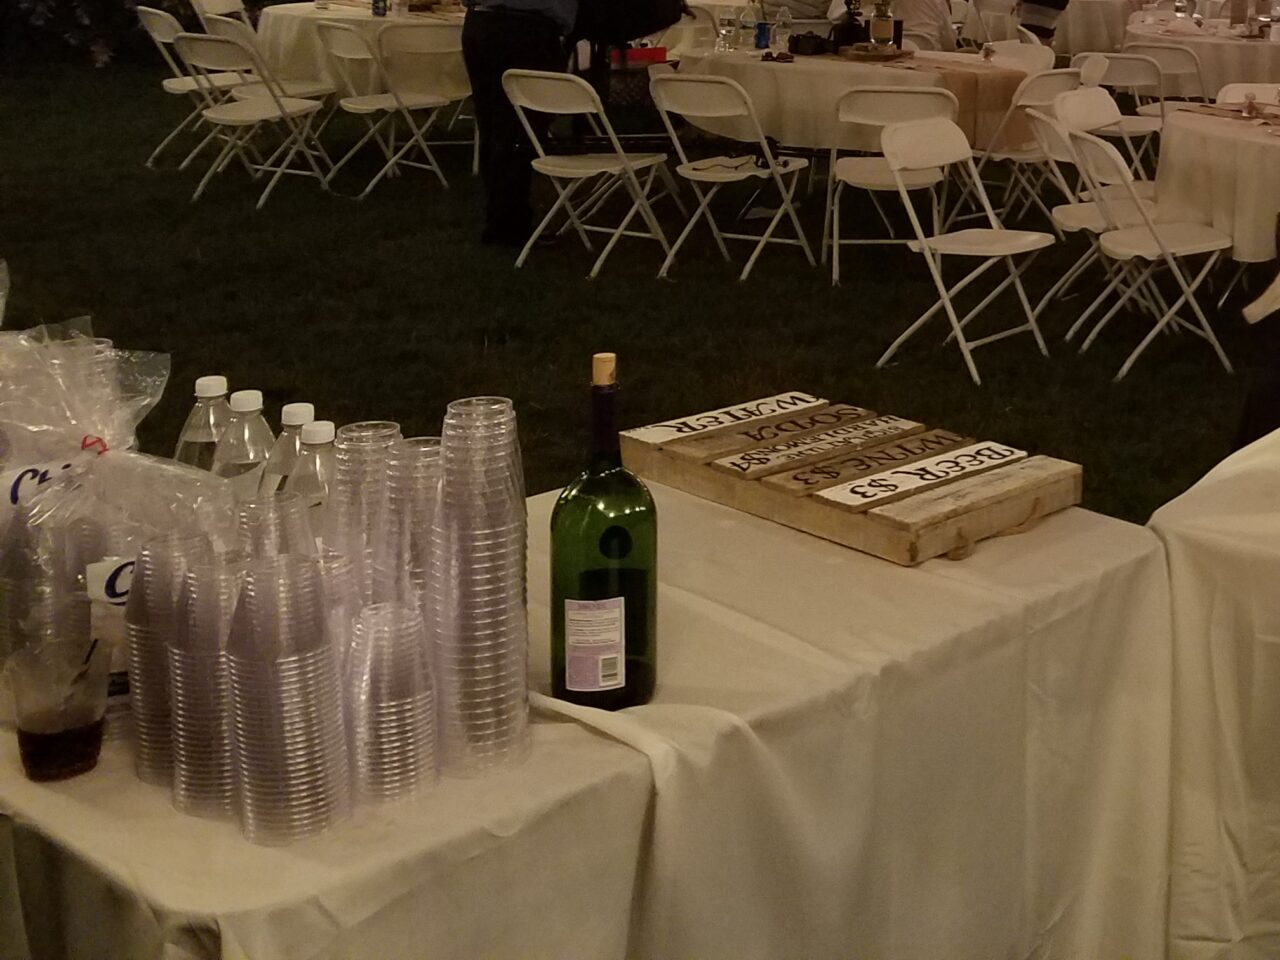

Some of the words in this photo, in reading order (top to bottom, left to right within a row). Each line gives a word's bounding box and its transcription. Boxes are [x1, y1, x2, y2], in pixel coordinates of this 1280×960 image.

[652, 394, 820, 434] WATER
[736, 408, 861, 442] SODA
[730, 449, 771, 472] $4
[841, 430, 964, 471] WINE
[890, 445, 1014, 481] BEER
[792, 465, 842, 486] $3
[849, 478, 900, 499] $3
